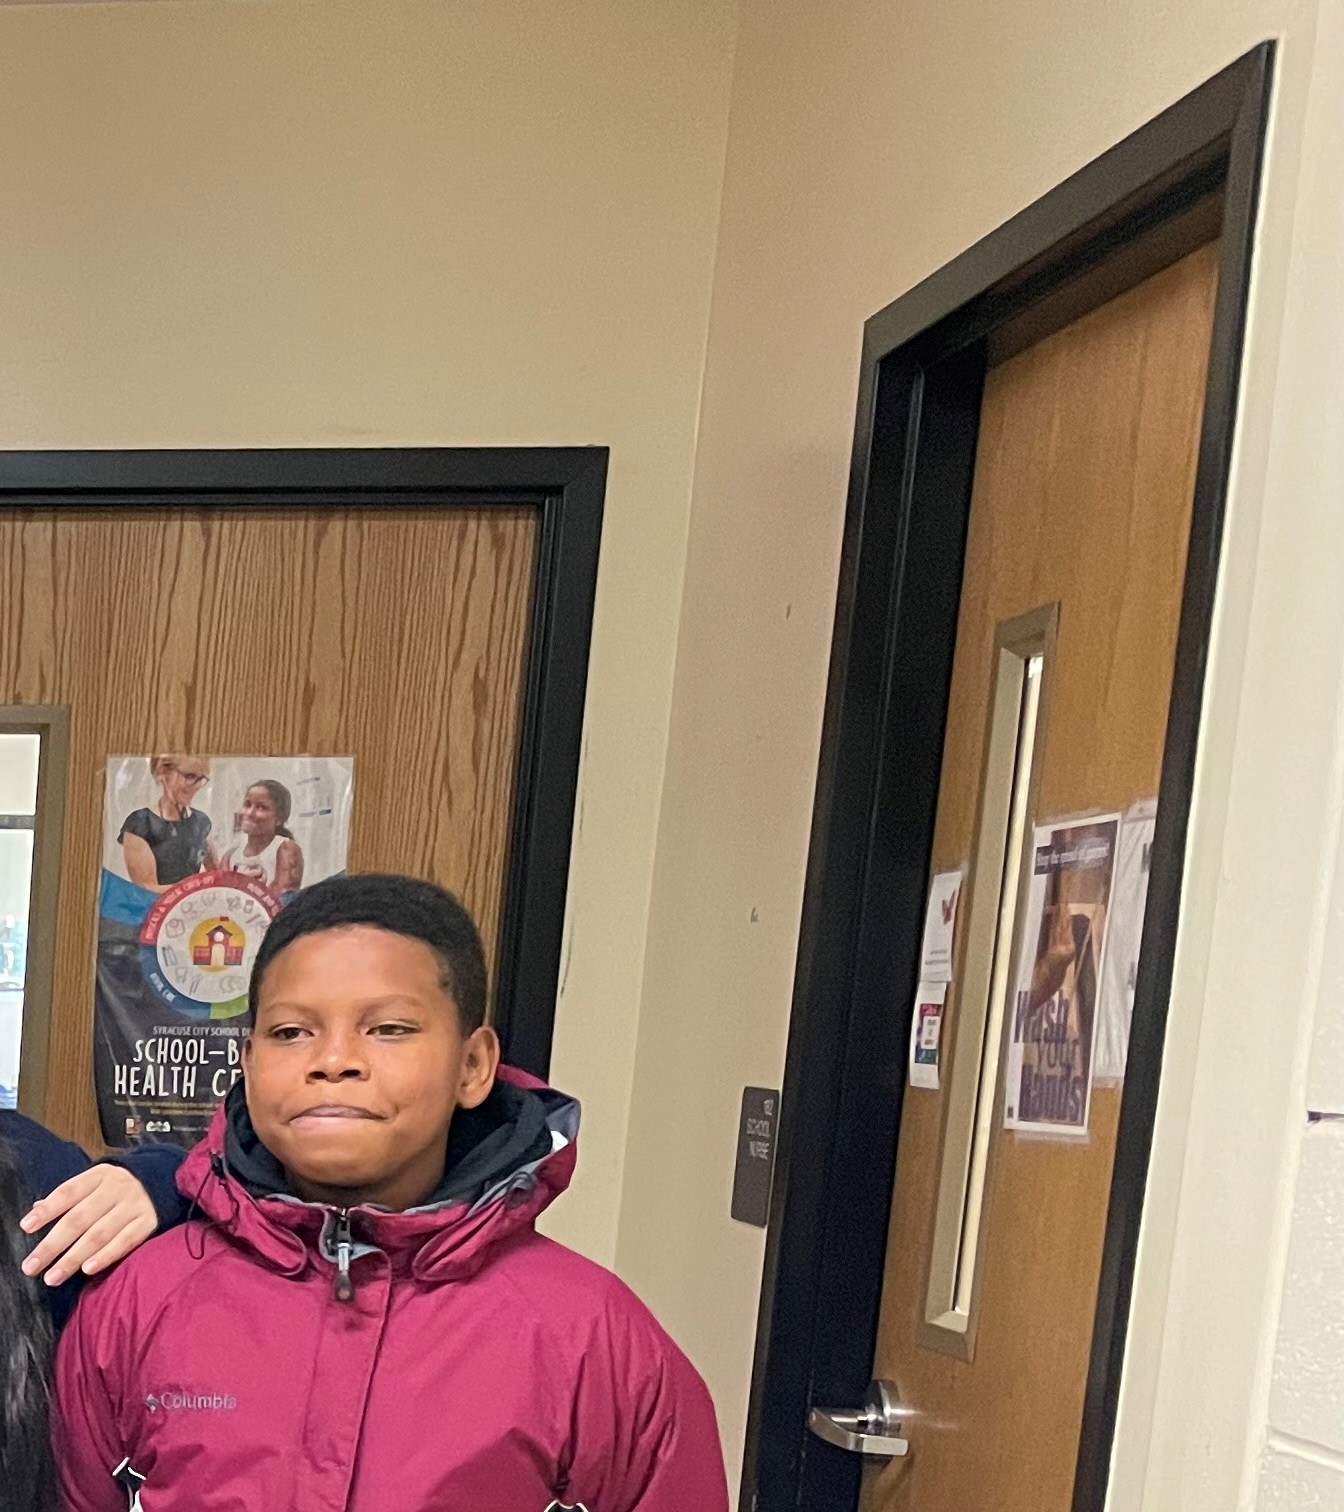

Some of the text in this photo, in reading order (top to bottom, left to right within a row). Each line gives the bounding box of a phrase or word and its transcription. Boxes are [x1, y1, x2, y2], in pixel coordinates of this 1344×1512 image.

[153, 1025, 191, 1036] SYRACUSE
[192, 1026, 209, 1036] CITY
[210, 1026, 239, 1037] SCHOOL
[1014, 990, 1068, 1043] Wash
[132, 1037, 240, 1066] SCHOOL-B
[114, 1064, 197, 1098] HEALTH
[161, 1392, 237, 1410] Columbia
